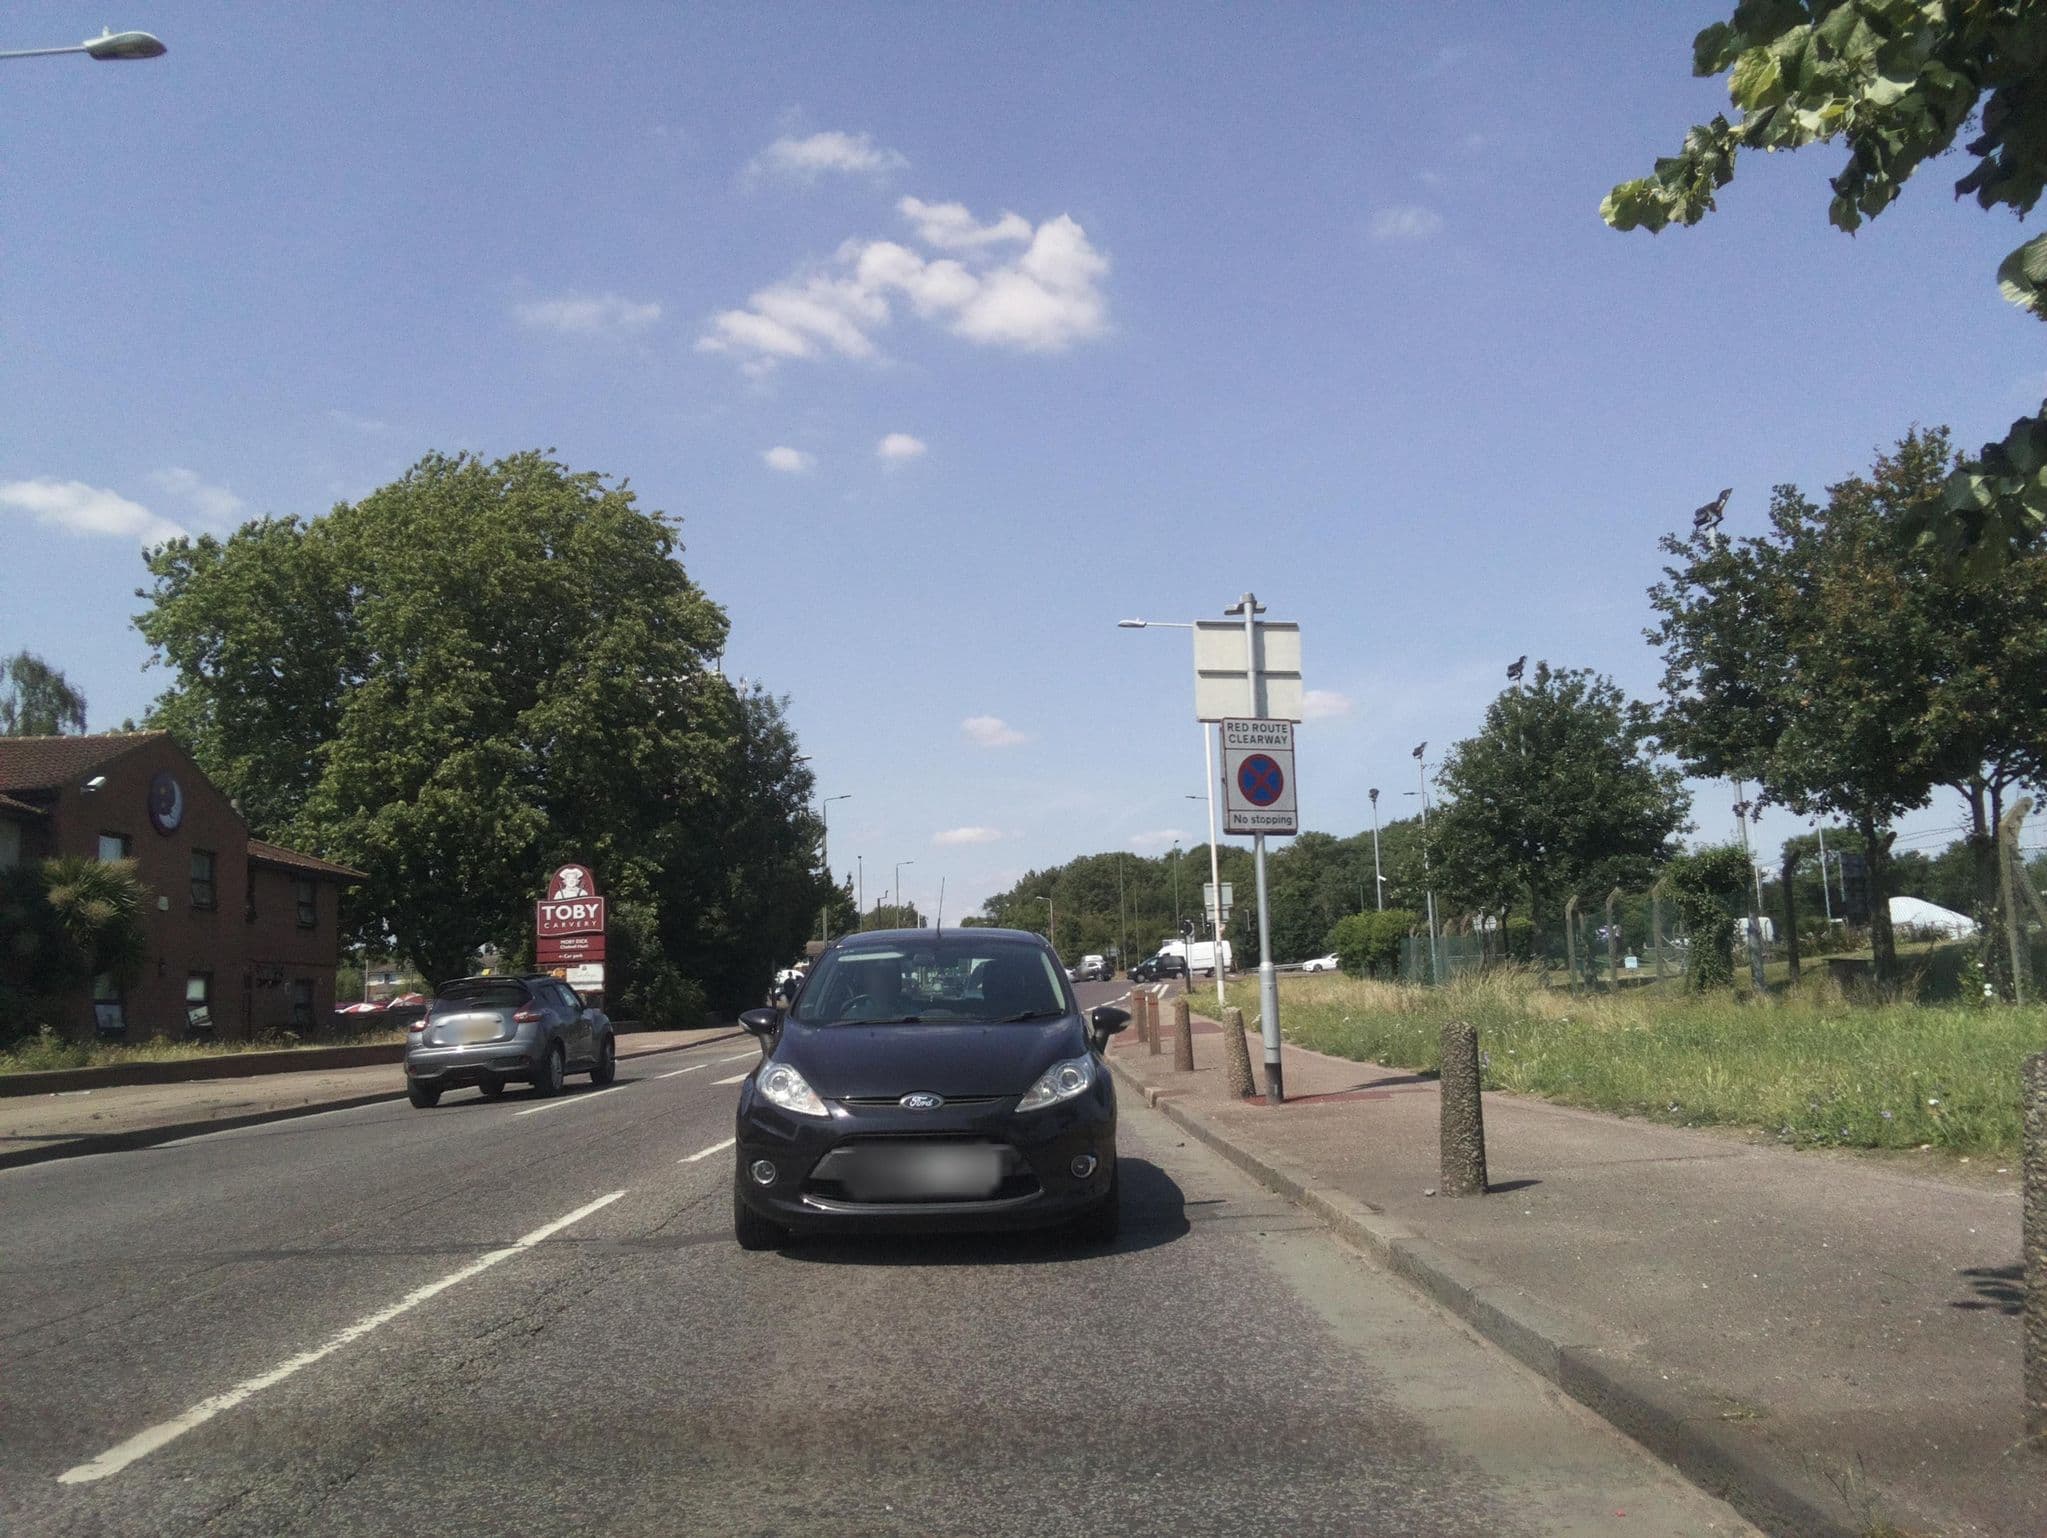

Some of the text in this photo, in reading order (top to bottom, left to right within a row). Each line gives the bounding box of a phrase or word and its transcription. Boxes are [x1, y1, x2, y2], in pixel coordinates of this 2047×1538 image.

[1227, 723, 1288, 733] RED ROUTE
[1228, 734, 1288, 745] CLEARWAY
[1233, 814, 1293, 826] No stopping
[541, 904, 599, 921] TOBY
[543, 921, 598, 929] CARVERY
[910, 1096, 934, 1107] Ford
